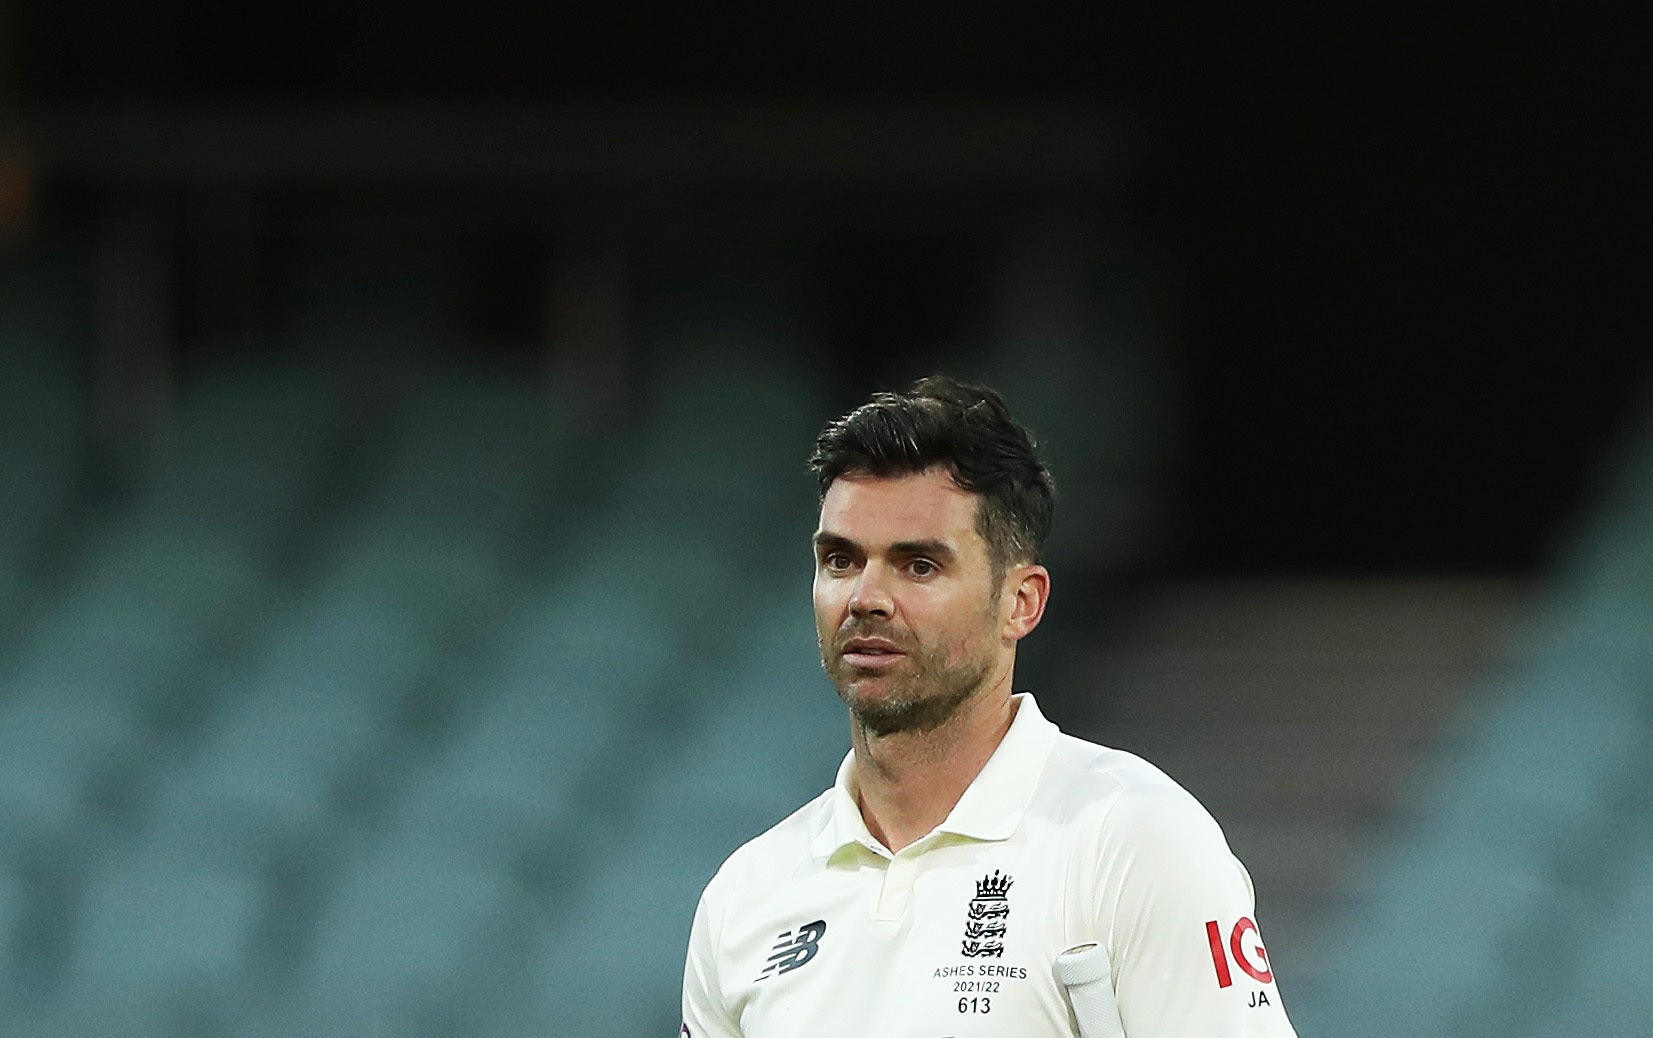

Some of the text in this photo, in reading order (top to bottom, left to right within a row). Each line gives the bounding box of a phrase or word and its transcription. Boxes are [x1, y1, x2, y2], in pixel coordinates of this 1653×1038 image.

[1205, 916, 1273, 989] IG
[933, 964, 1028, 980] ASHES SERIES
[953, 981, 1001, 993] 2021/22
[957, 997, 991, 1014] 613
[1247, 990, 1271, 1008] JA
